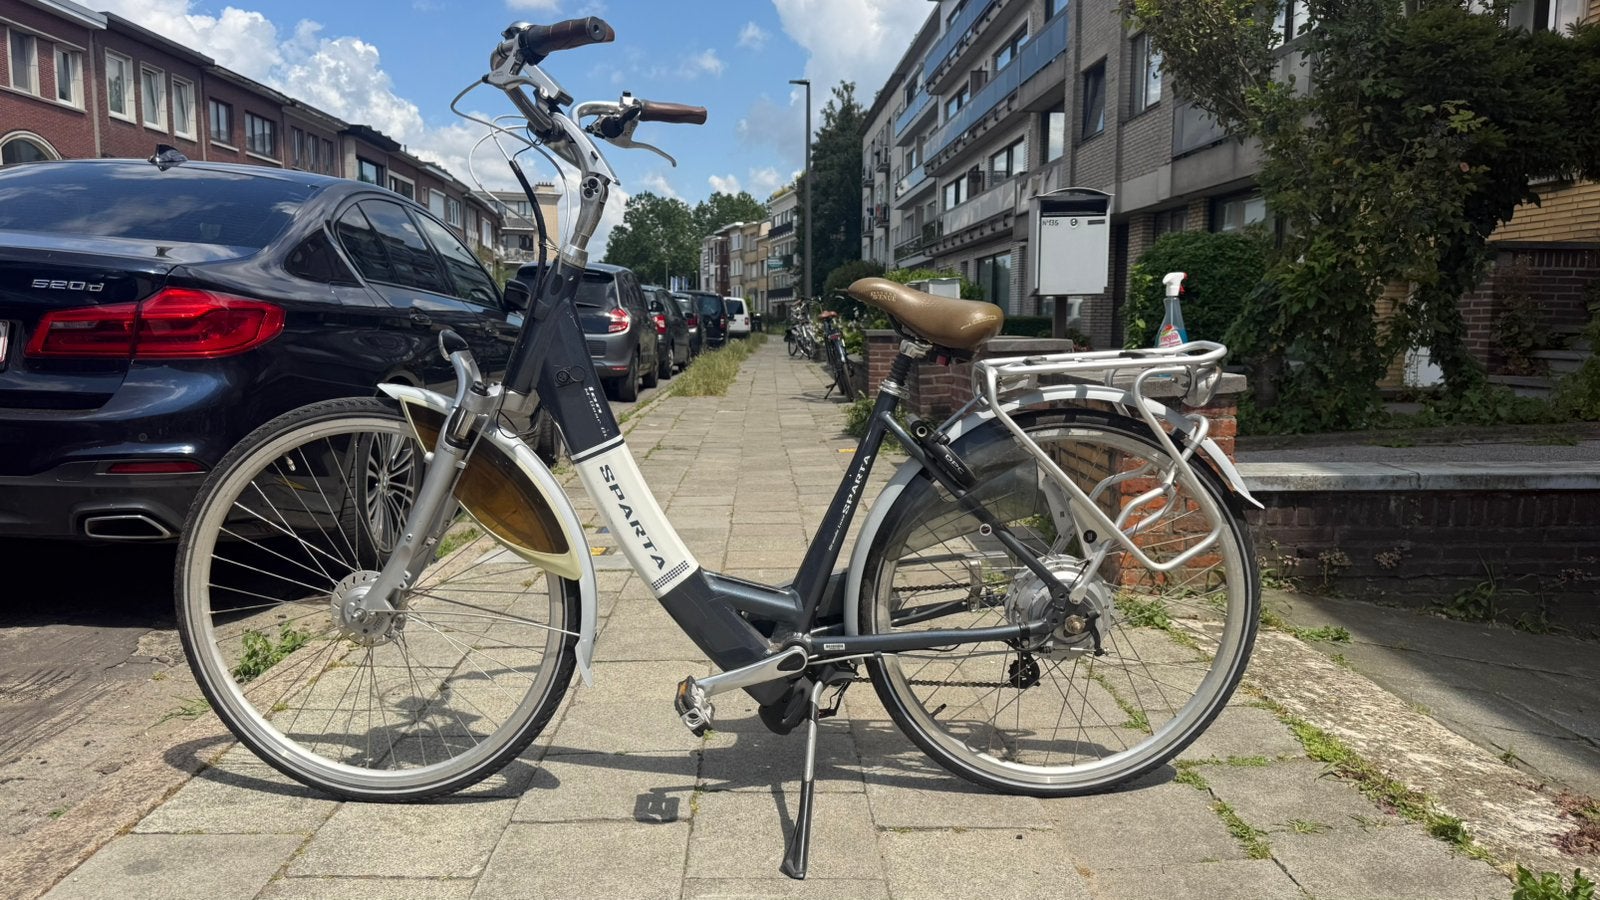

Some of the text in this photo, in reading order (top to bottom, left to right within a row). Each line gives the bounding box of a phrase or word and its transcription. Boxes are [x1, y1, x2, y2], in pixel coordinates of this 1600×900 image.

[32, 279, 104, 292] 520d
[842, 455, 871, 516] SPARTA
[599, 464, 666, 570] SPARTA
